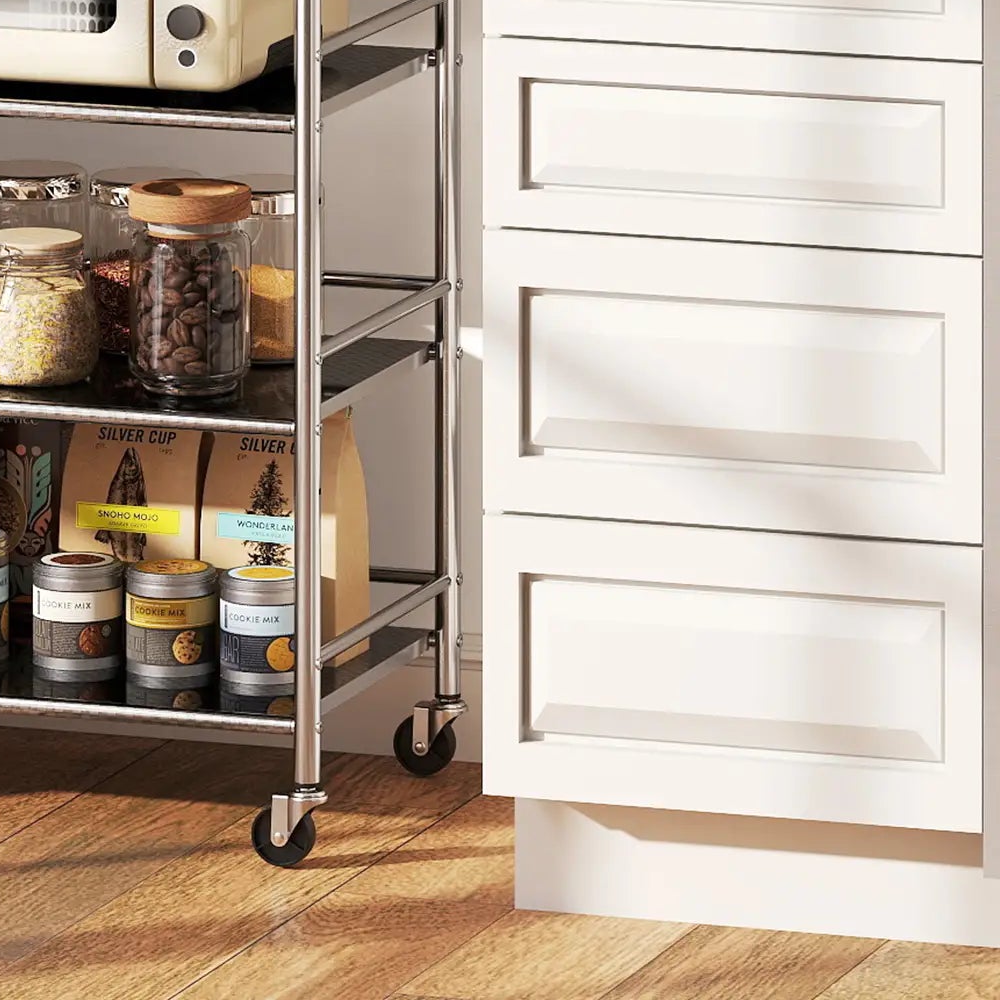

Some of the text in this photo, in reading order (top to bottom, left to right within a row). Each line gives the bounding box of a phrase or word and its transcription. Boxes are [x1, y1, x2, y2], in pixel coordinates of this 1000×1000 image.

[97, 426, 177, 445] SILVER CUP
[239, 437, 286, 455] SILVER
[133, 512, 159, 522] MOJO
[236, 519, 294, 532] WONDERLAN
[41, 599, 92, 610] COOKIE MIX
[135, 605, 165, 616] COOKIE
[168, 608, 186, 617] MIX
[229, 612, 280, 624] COOKIE MIX
